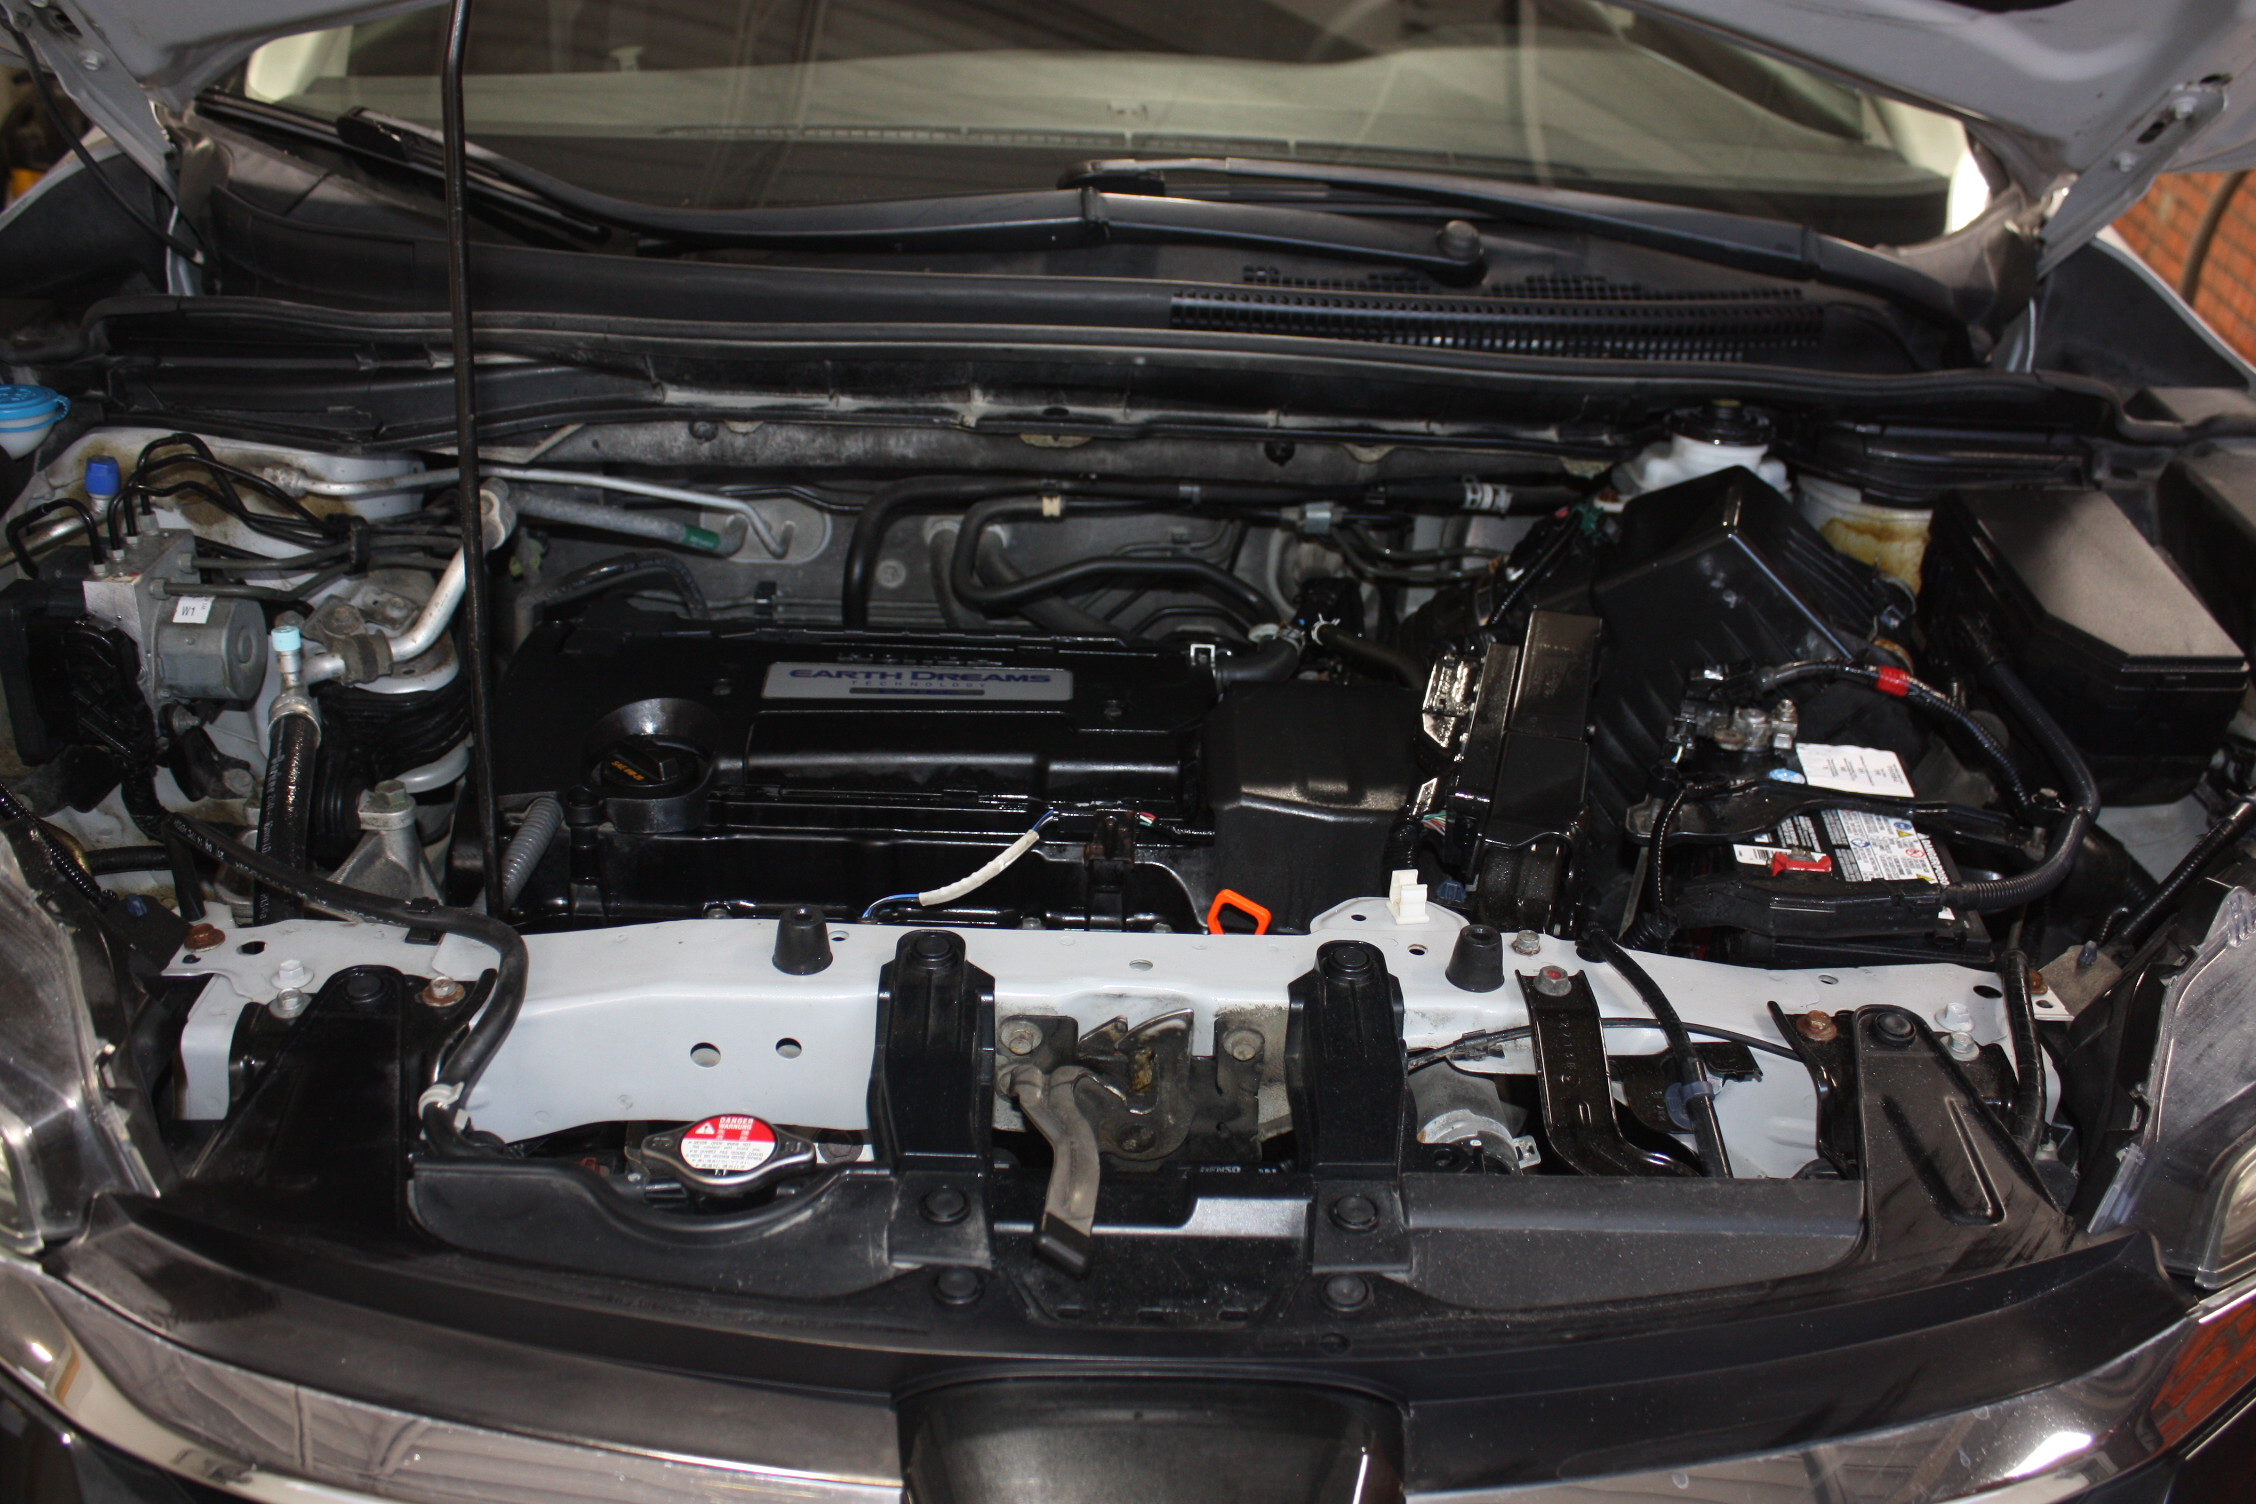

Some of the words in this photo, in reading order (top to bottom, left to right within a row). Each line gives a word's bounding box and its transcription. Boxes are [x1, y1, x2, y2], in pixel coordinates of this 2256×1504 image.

[182, 606, 196, 616] W1
[789, 669, 903, 680] EARTH
[910, 670, 1051, 683] DREAMS
[852, 680, 987, 689] TECHNOLOGY
[719, 1117, 754, 1125] DANGER
